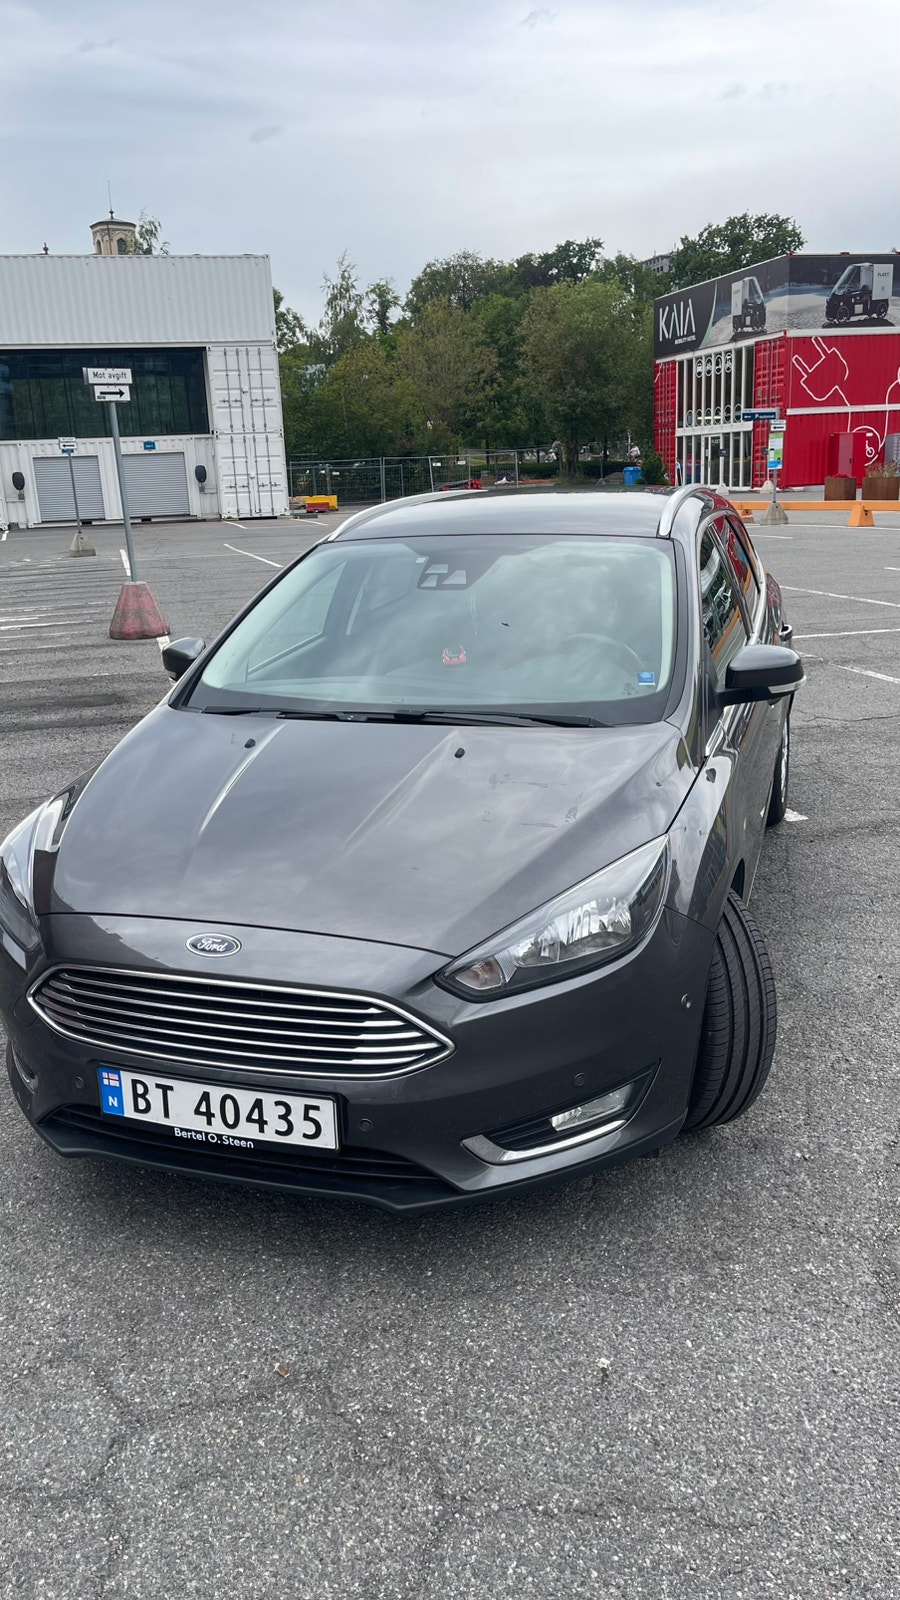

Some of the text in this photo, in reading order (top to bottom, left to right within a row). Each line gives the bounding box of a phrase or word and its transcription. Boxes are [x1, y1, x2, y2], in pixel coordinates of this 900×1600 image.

[659, 298, 696, 343] KAIA
[93, 371, 127, 381] Mot avgift
[197, 937, 228, 952] Ford
[108, 1096, 118, 1108] N
[131, 1078, 323, 1140] BT 40435
[174, 1127, 254, 1149] Bertel O. Steen
